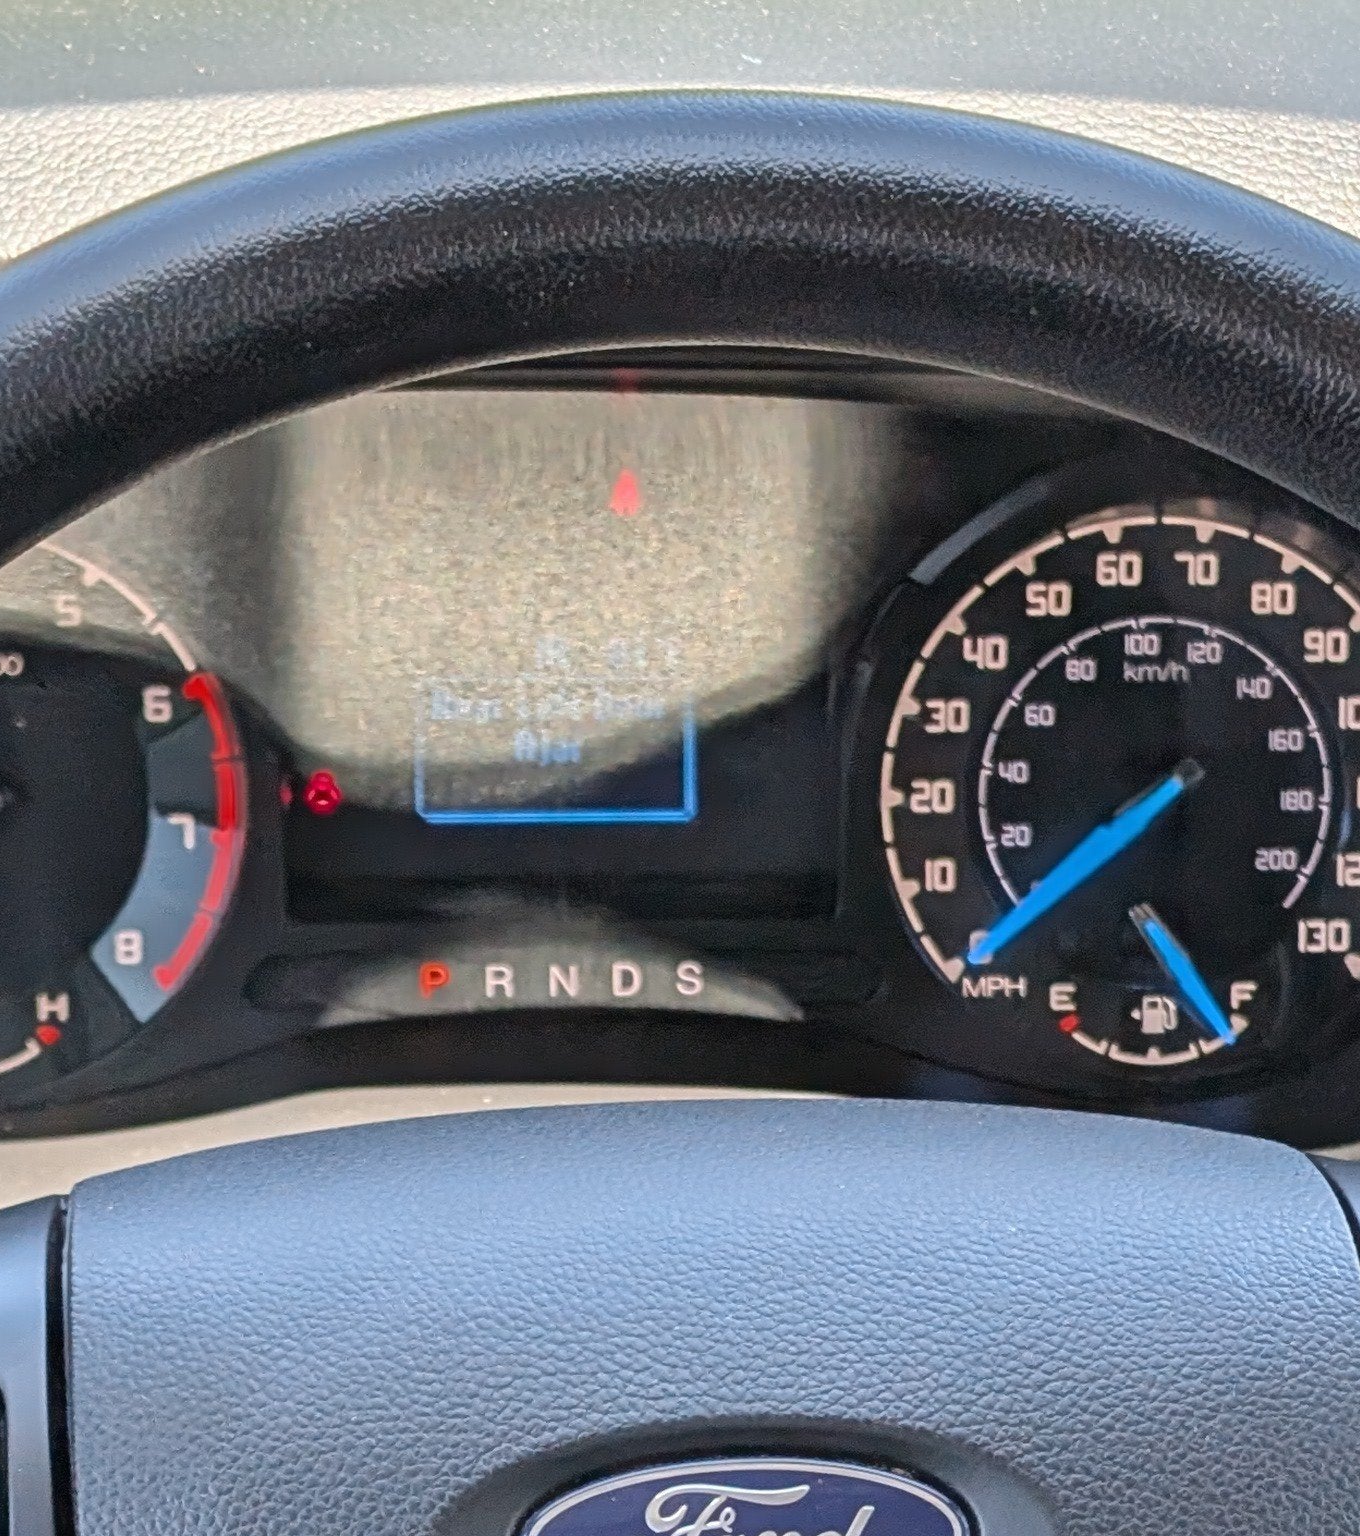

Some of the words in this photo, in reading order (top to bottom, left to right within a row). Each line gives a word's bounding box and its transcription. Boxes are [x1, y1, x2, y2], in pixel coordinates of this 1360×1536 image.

[1095, 552, 1143, 588] 60
[1175, 552, 1219, 586] 70
[55, 594, 81, 627] 5
[1025, 582, 1072, 617] 50
[1250, 581, 1296, 617] 80
[963, 636, 1008, 670] 40
[1123, 634, 1159, 657] 100
[1186, 641, 1223, 666] 120
[1303, 630, 1349, 664] 90
[1064, 658, 1097, 683] 80
[1122, 657, 1190, 682] km/h
[143, 686, 170, 723] 6
[1236, 677, 1273, 701] 140
[923, 699, 970, 734] 30
[1024, 703, 1056, 727] 60
[1268, 729, 1304, 753] 160
[998, 760, 1031, 785] 40
[909, 779, 955, 814] 20
[1279, 789, 1314, 813] 180
[169, 815, 196, 851] 7
[1000, 825, 1033, 848] 20
[924, 859, 956, 893] 10
[1254, 849, 1299, 874] 200
[114, 931, 142, 965] 8
[1298, 920, 1350, 954] 130
[418, 961, 450, 998] P
[484, 963, 514, 998] R
[547, 964, 580, 998] N
[611, 962, 642, 998] D
[675, 961, 705, 996] S
[961, 975, 1028, 998] MPH
[36, 994, 70, 1022] H
[1049, 982, 1078, 1012] E
[1231, 982, 1258, 1009] F
